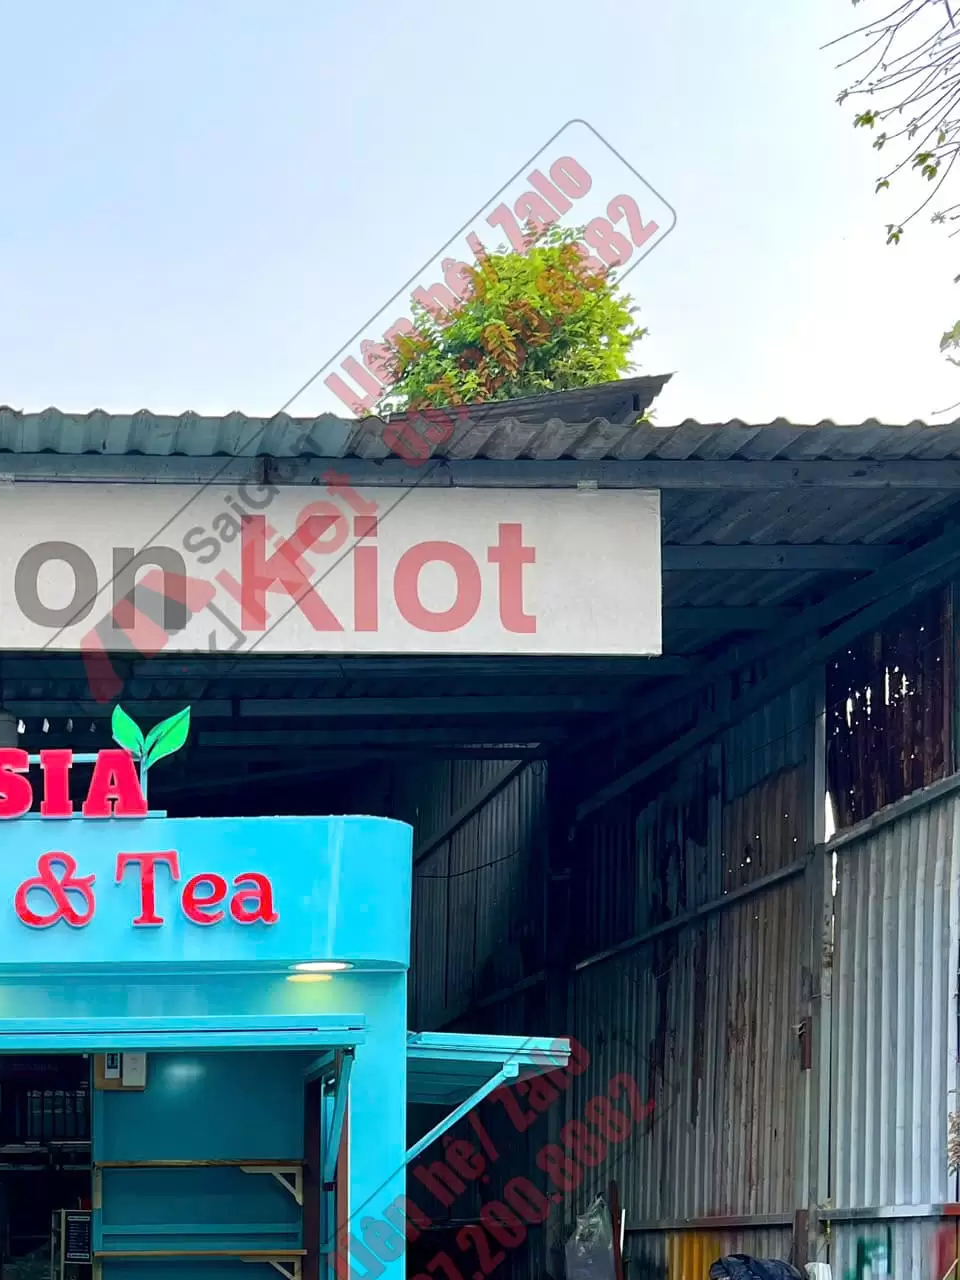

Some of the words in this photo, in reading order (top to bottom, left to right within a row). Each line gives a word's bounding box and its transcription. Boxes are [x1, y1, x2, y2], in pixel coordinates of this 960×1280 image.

[240, 514, 537, 634] Kiot
[14, 850, 96, 929] &
[112, 850, 280, 928] Tea
